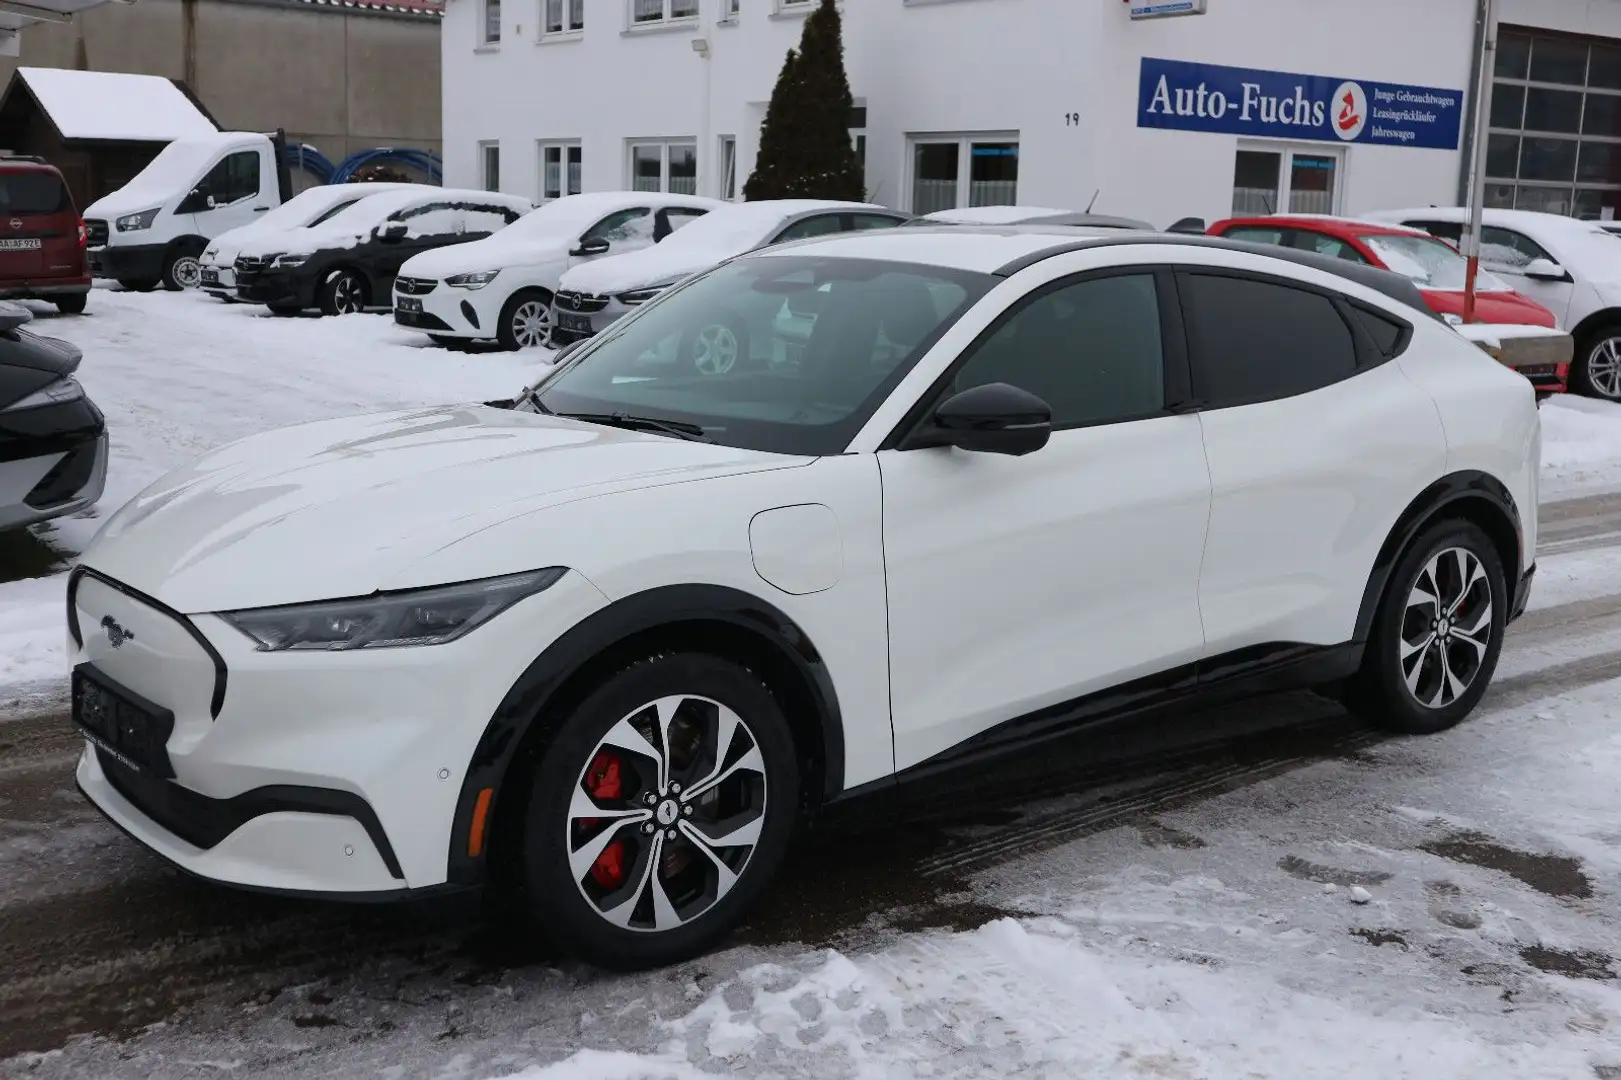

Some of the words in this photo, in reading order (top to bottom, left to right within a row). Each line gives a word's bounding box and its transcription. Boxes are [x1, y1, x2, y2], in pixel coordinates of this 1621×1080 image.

[1147, 74, 1325, 127] Auto-Fuchs
[1374, 88, 1395, 103] Junge
[1396, 90, 1455, 108] Gebrauchtwagen
[1065, 112, 1080, 126] 19
[1373, 107, 1437, 124] Leasingrückläufer
[1371, 126, 1415, 142] Jahreswagen
